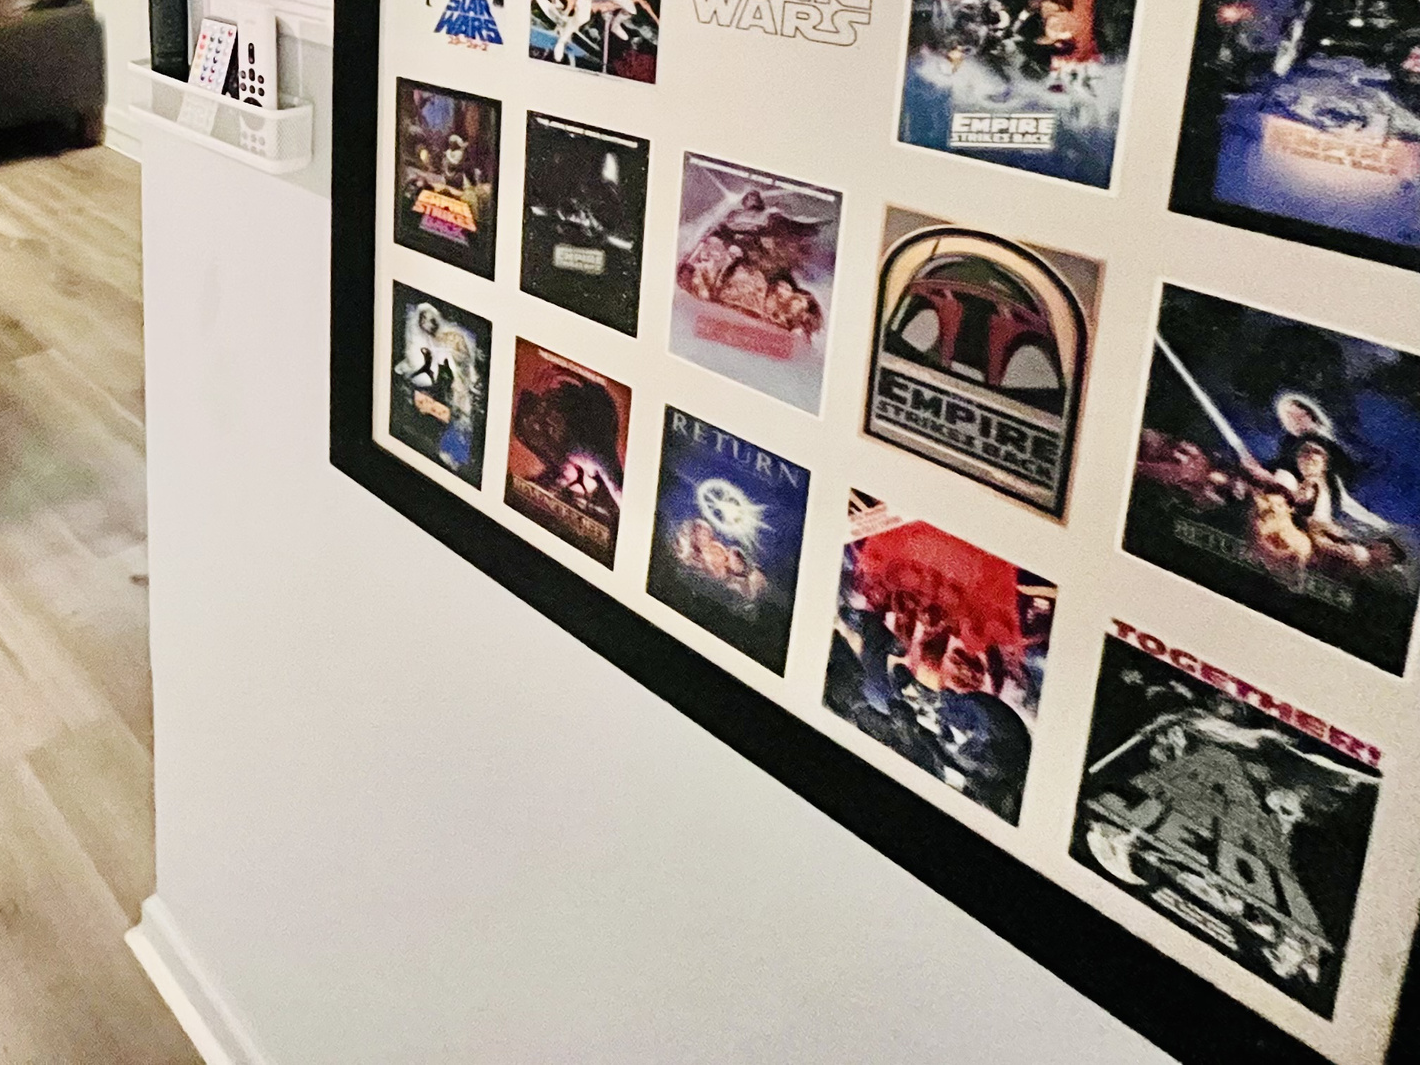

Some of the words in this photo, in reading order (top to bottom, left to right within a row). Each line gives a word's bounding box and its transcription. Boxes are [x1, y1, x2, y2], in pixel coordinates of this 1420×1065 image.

[434, 10, 504, 45] WARS
[951, 113, 1055, 133] EMPIRE
[672, 411, 799, 489] RETURN
[877, 367, 1062, 467] EMPIRE
[1090, 792, 1327, 939] JEDI
